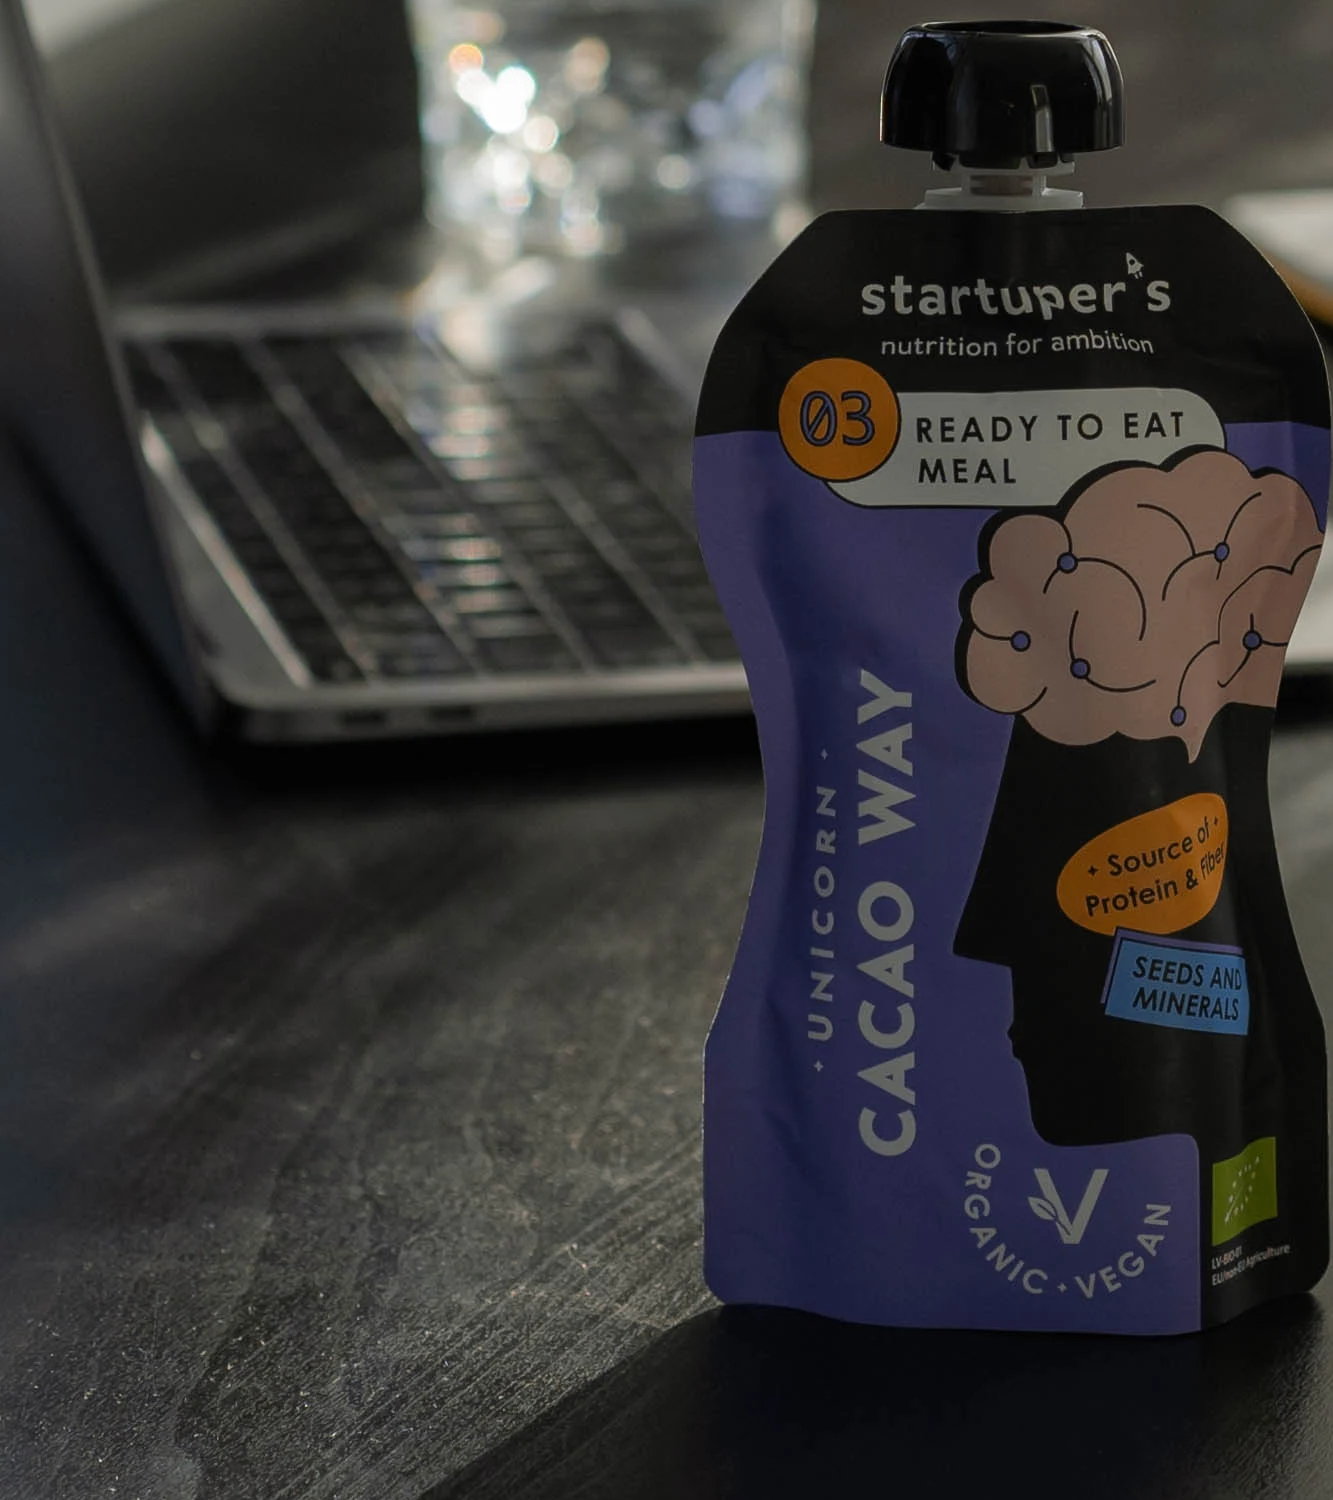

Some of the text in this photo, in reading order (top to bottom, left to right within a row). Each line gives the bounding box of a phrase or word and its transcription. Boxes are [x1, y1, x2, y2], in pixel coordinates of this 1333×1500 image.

[861, 252, 1171, 319] startuper's
[881, 328, 1154, 356] nutrition for ambition
[800, 390, 876, 447] 03
[916, 411, 1183, 443] READY TO EAT
[918, 458, 1016, 484] MEAL
[1107, 816, 1210, 877] Source of
[1086, 842, 1224, 917] Protein & Fiber
[807, 786, 837, 1041] UNICORN
[856, 669, 917, 1156] CACAO WAY
[1132, 956, 1242, 990] SEEDS AND
[1132, 986, 1240, 1021] MINERALS
[964, 1143, 1171, 1299] ORGANIC VEGAN
